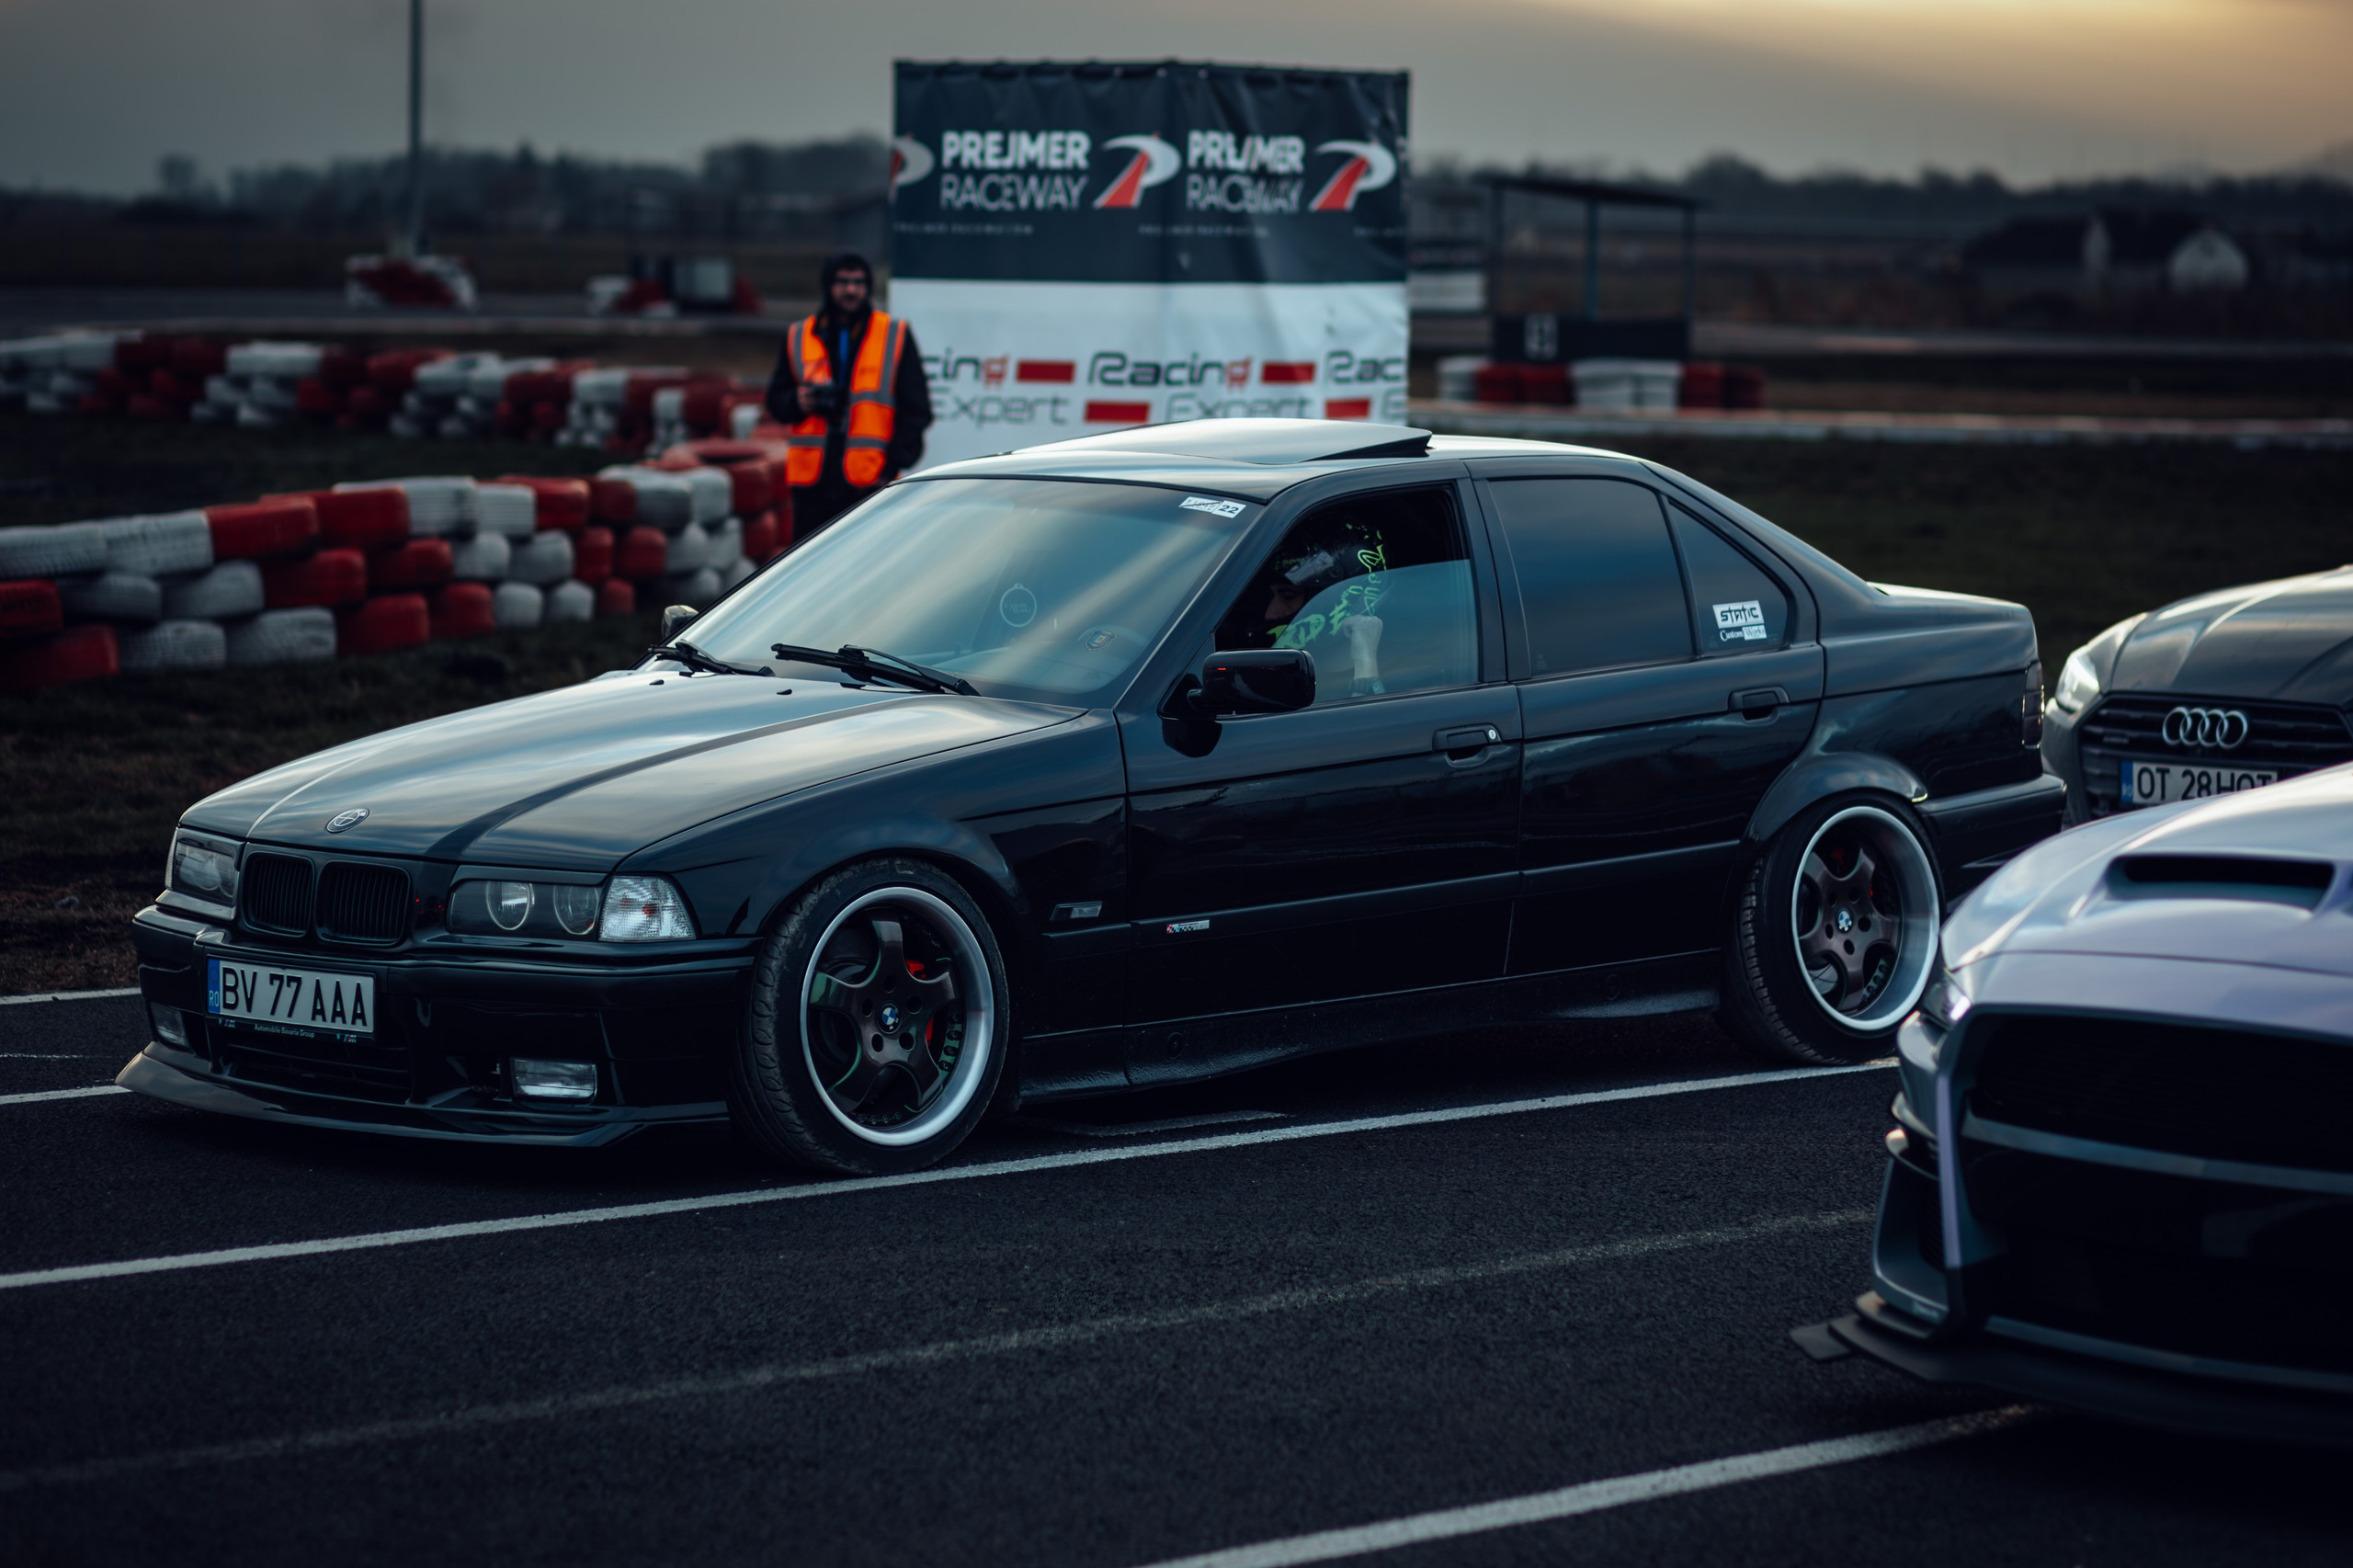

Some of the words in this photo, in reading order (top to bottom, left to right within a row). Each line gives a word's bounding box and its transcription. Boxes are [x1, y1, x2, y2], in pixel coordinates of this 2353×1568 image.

[942, 130, 1091, 170] PREJMER
[940, 173, 1089, 211] RACEWAY
[921, 347, 1009, 390] cing
[1087, 351, 1253, 393] Racing
[1324, 350, 1404, 386] Rac
[1218, 504, 1239, 515] 22
[1720, 630, 1745, 642] Custom
[2137, 767, 2170, 801] OT
[2181, 768, 2212, 801] 28
[209, 989, 220, 1007] RO
[222, 966, 257, 1013] BV
[268, 972, 302, 1018] 77
[311, 977, 368, 1028] AAA
[254, 1023, 281, 1035] Automobile
[281, 1027, 300, 1037] Bavaria
[300, 1028, 315, 1040] Group
